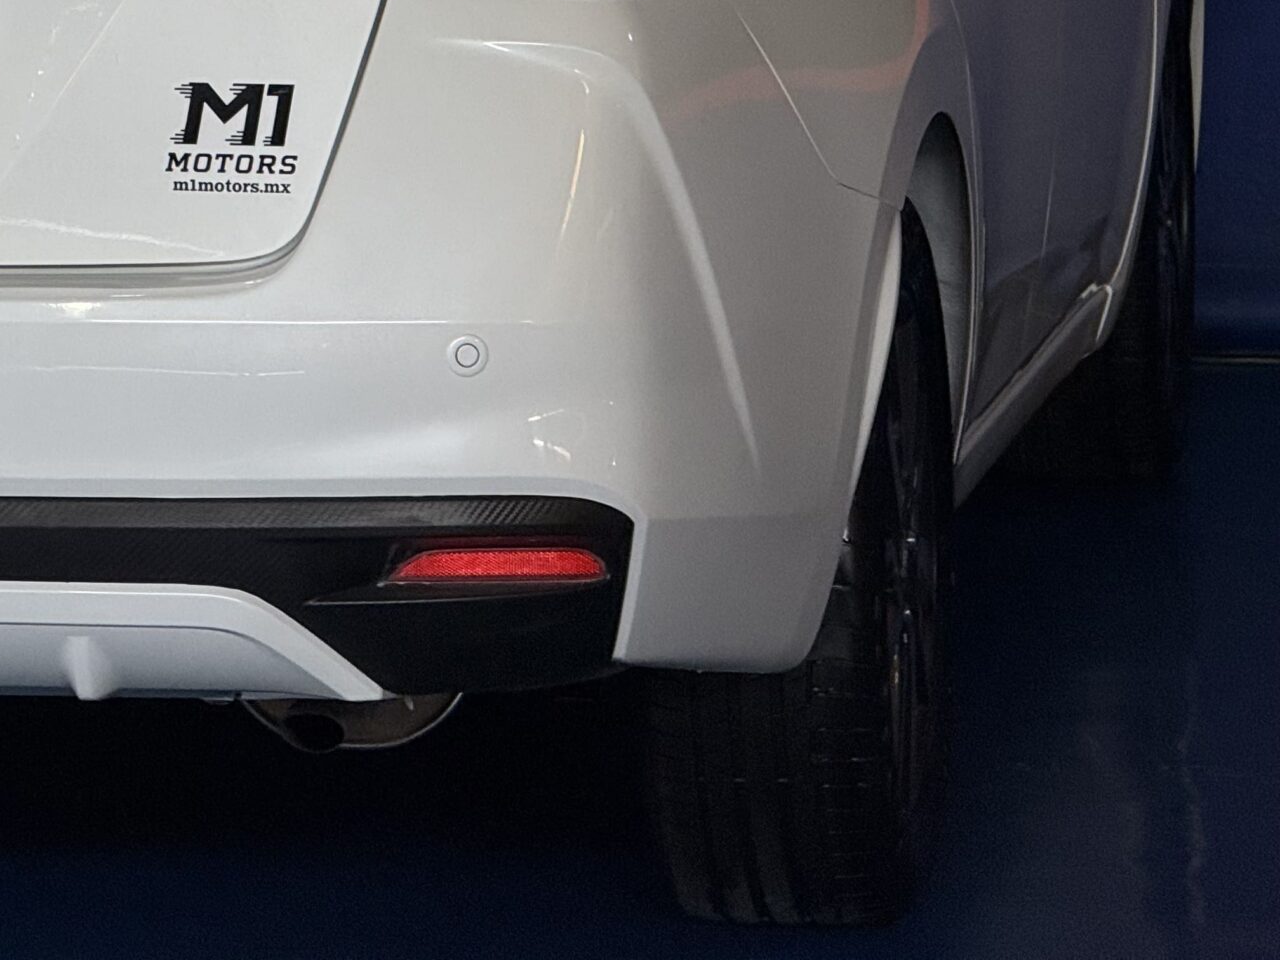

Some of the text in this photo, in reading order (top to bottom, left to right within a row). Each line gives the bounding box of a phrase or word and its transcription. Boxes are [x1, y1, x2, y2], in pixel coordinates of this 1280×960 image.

[169, 82, 295, 147] M1
[165, 152, 298, 175] MOTORS
[173, 179, 292, 194] m1motors.mx
